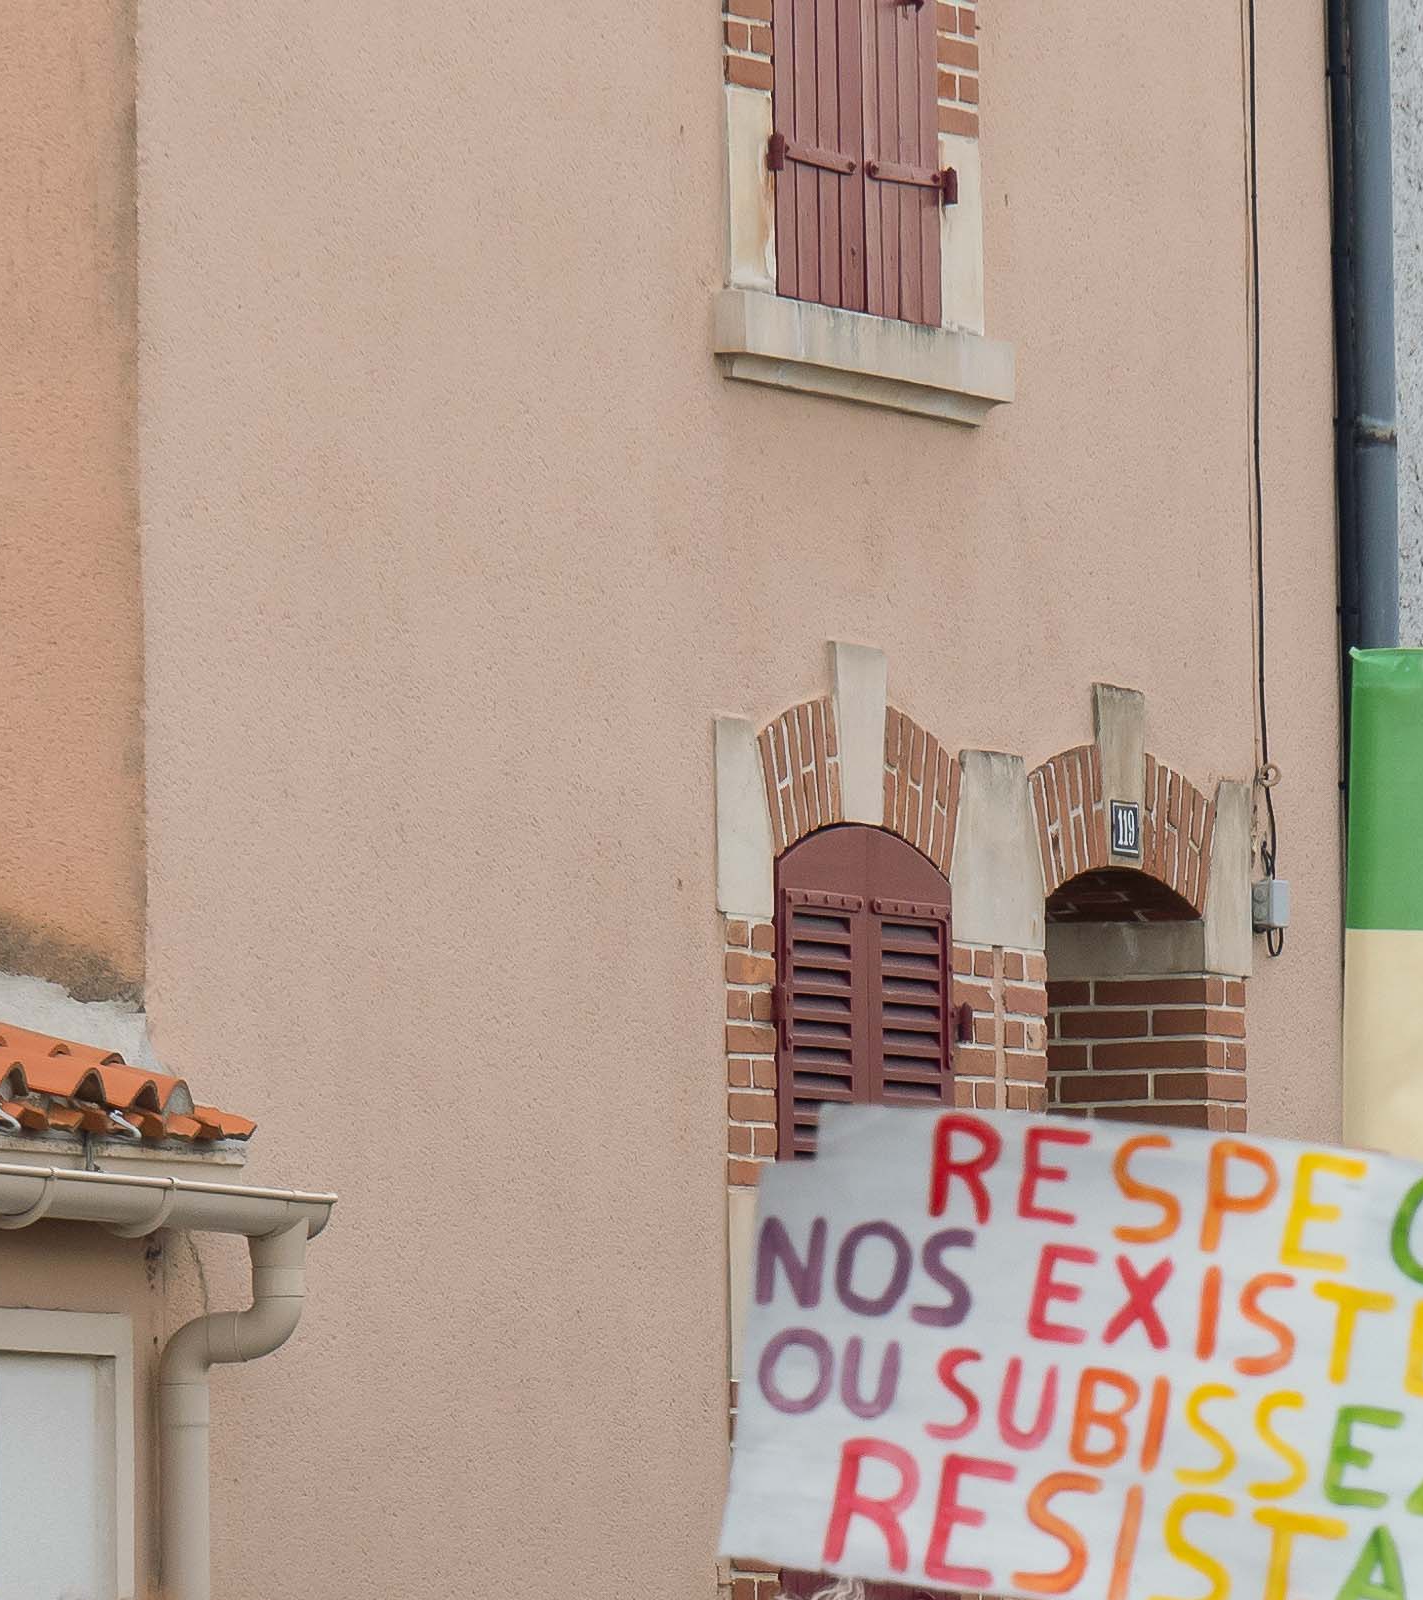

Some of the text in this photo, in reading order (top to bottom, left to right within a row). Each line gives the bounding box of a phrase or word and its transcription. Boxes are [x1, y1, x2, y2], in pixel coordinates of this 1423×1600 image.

[1118, 809, 1135, 847] 119
[755, 1216, 975, 1327] NOS
[758, 1328, 900, 1419] OU
